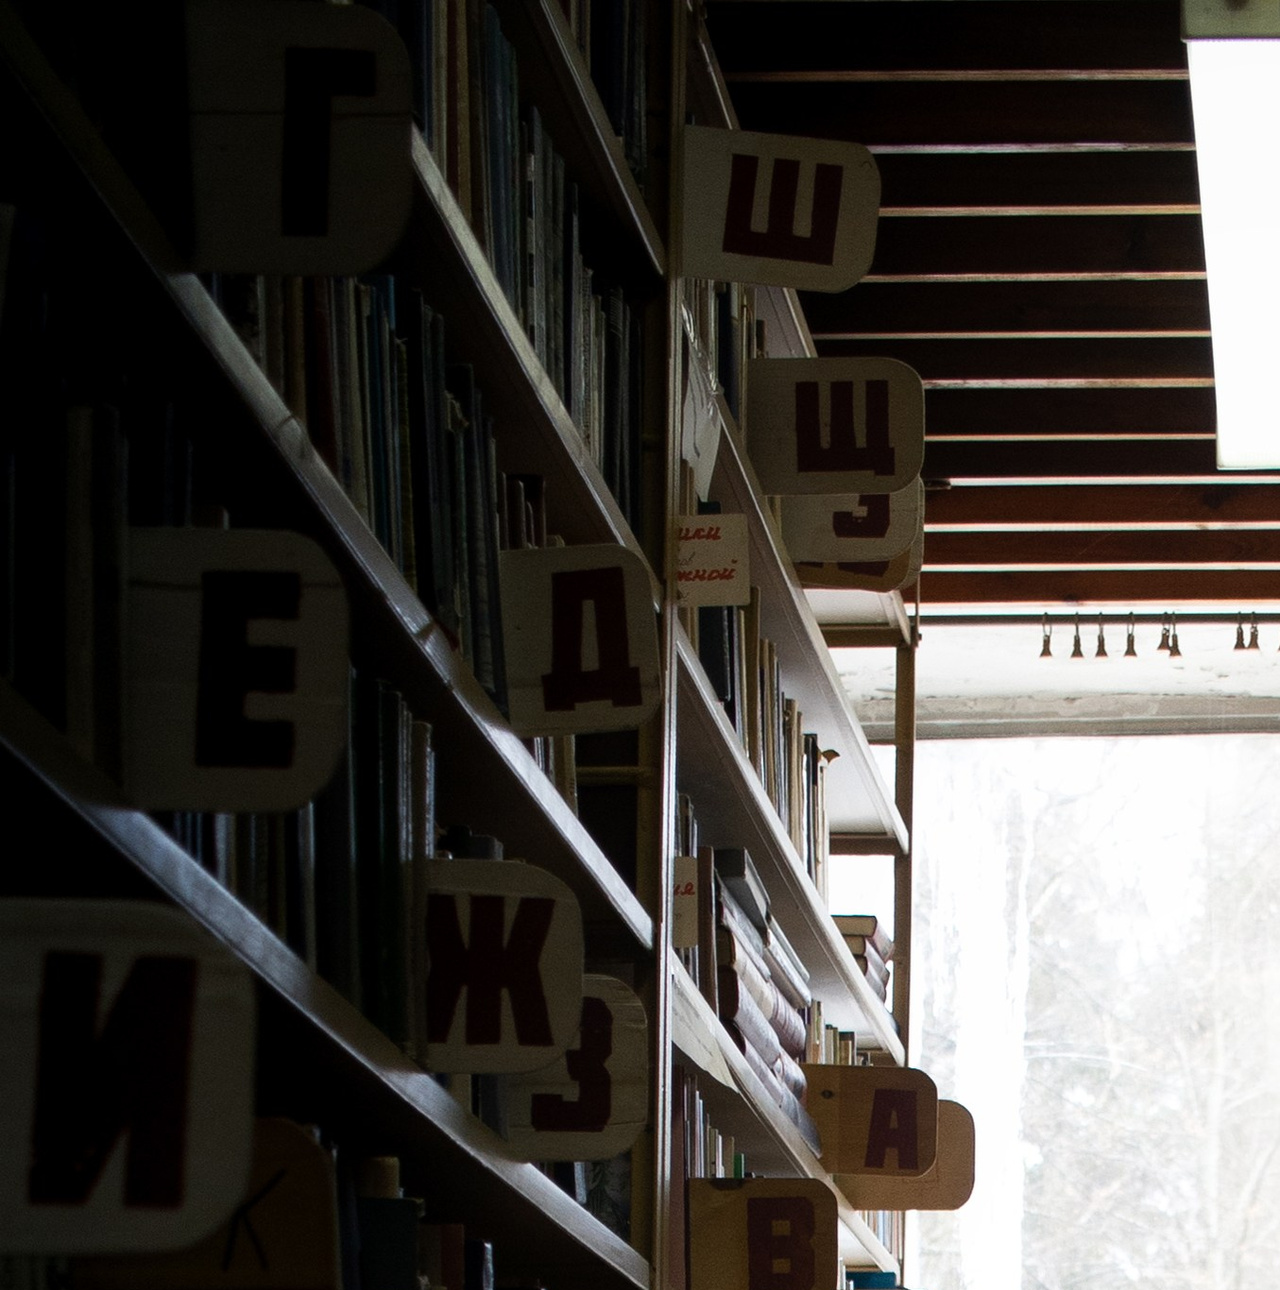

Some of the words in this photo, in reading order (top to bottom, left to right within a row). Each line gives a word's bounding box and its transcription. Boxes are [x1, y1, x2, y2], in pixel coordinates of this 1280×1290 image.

[283, 48, 375, 236] Г
[723, 153, 843, 266] Ш
[796, 379, 895, 476] Щ
[195, 571, 300, 767] Е
[541, 567, 643, 711] Д
[427, 894, 556, 1046] Ж
[29, 952, 196, 1206] И
[864, 1088, 919, 1170] А
